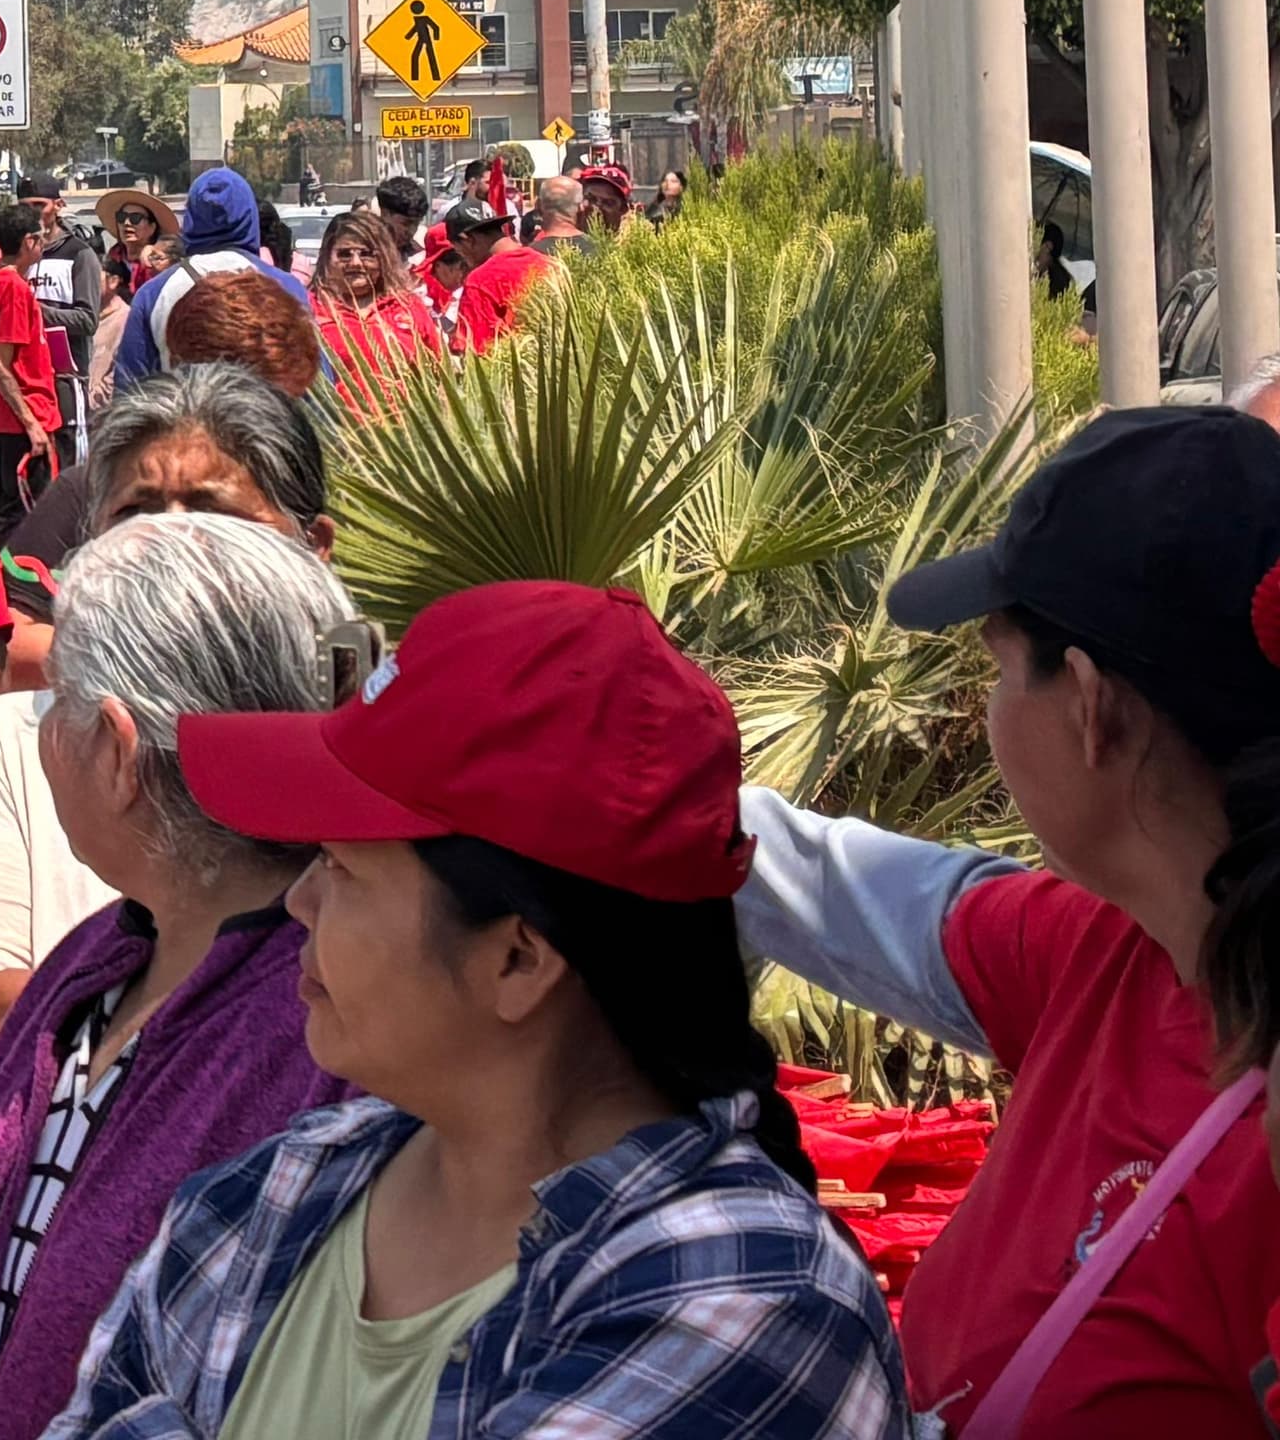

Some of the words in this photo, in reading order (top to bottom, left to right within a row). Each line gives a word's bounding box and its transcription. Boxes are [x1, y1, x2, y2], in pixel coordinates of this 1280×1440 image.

[1, 91, 14, 102] DE
[388, 110, 418, 122] CEDA
[420, 110, 433, 121] EL
[435, 107, 464, 120] PASO
[393, 125, 409, 137] AL
[412, 124, 461, 136] PEATON
